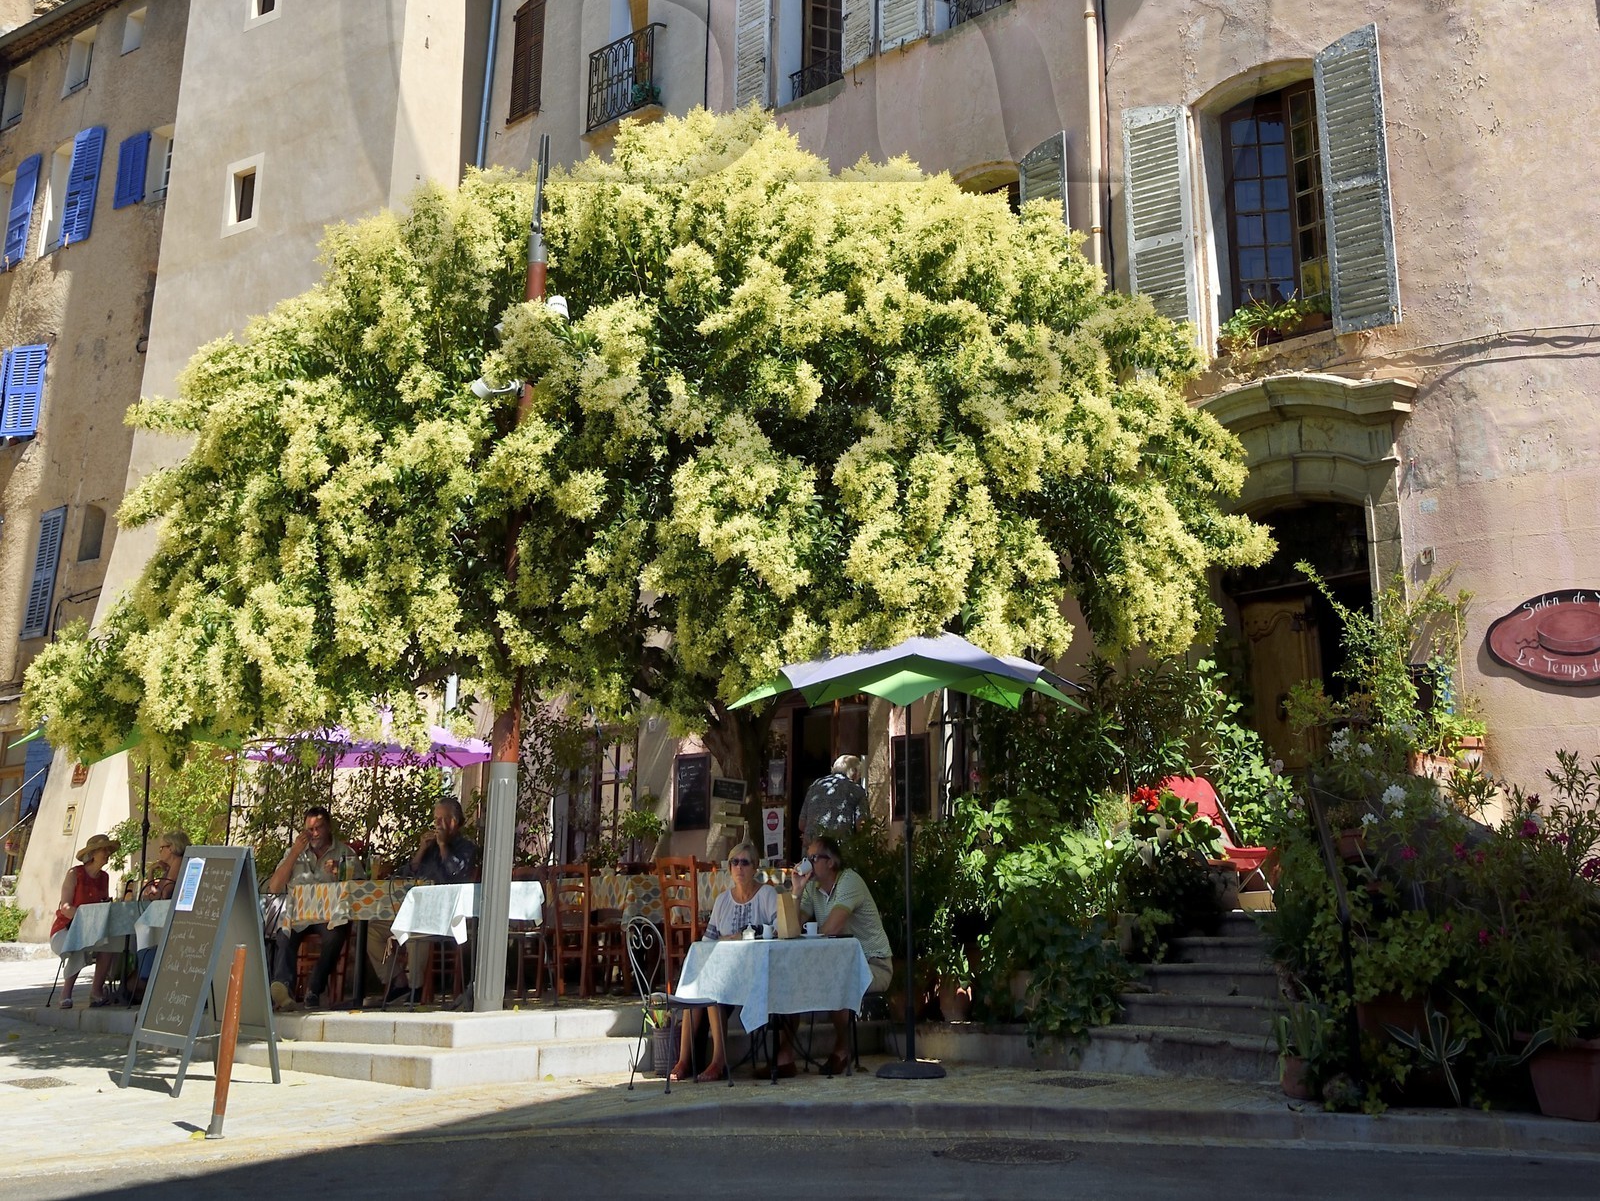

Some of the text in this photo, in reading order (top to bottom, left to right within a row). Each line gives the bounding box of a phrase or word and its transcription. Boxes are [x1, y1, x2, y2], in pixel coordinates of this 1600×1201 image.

[1422, 549, 1432, 559] 11
[1521, 595, 1559, 621] Salon
[1573, 591, 1586, 604] de
[1516, 649, 1600, 678] Le Temps d
